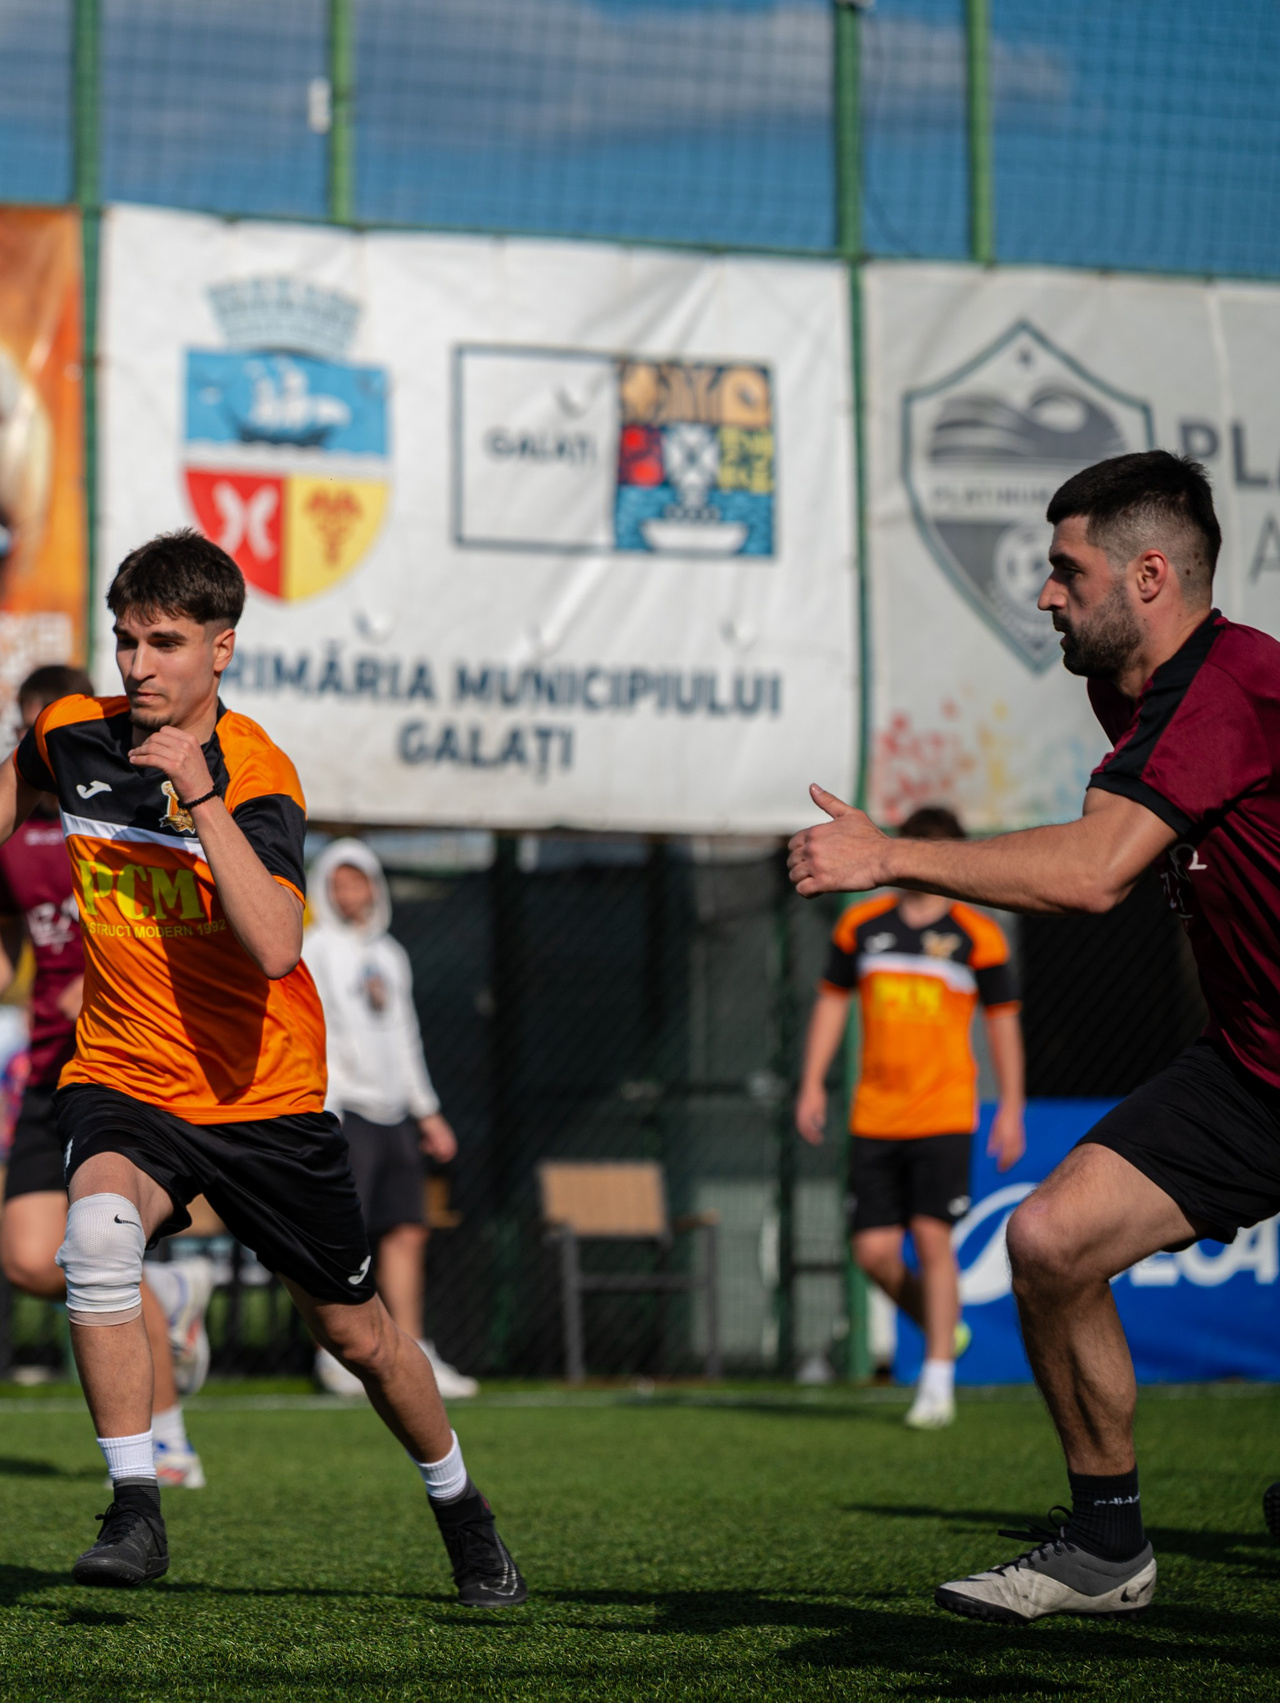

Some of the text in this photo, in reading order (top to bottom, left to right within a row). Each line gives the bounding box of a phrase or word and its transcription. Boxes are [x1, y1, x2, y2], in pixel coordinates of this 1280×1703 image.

[1179, 415, 1280, 486] PL
[453, 660, 783, 718] MUNICIPIULUI
[77, 858, 206, 921] PCM
[82, 918, 227, 939] STRUCT MODERN 1992
